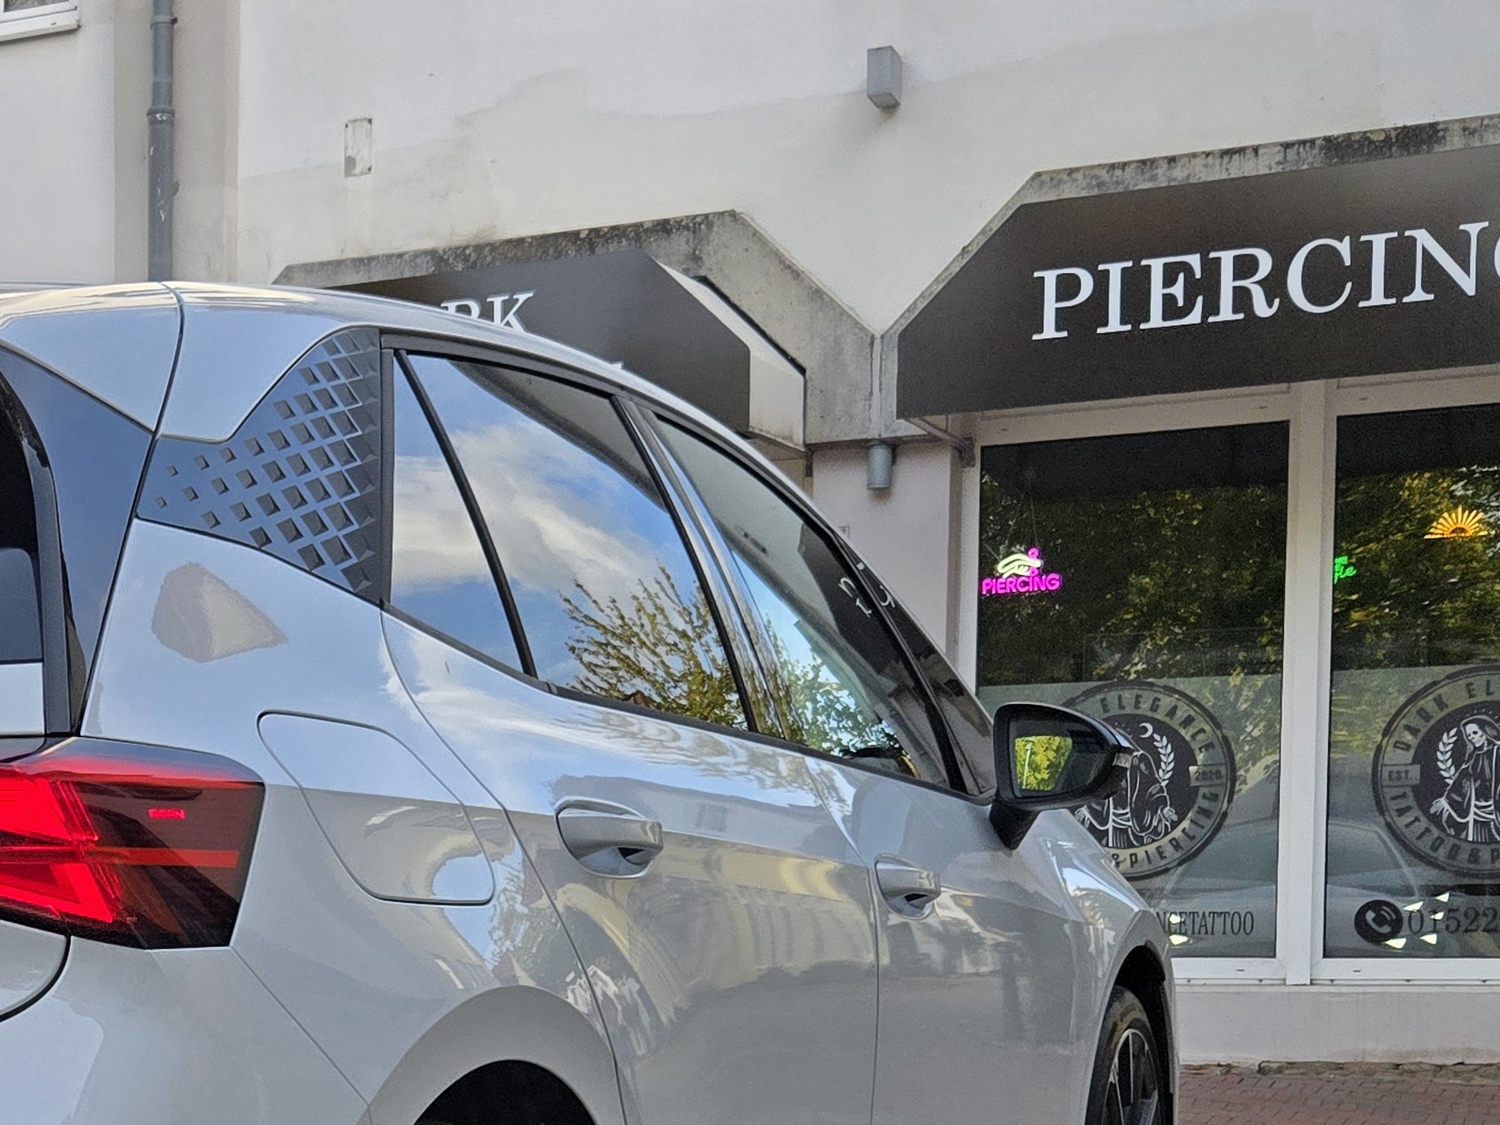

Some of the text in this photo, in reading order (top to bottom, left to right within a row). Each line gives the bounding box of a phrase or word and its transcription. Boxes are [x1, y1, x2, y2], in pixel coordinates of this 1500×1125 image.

[1031, 221, 1500, 341] PIERCIN
[982, 573, 1061, 595] PIERCING
[1101, 694, 1216, 754] ELEGANCE
[1393, 693, 1449, 752] DARK
